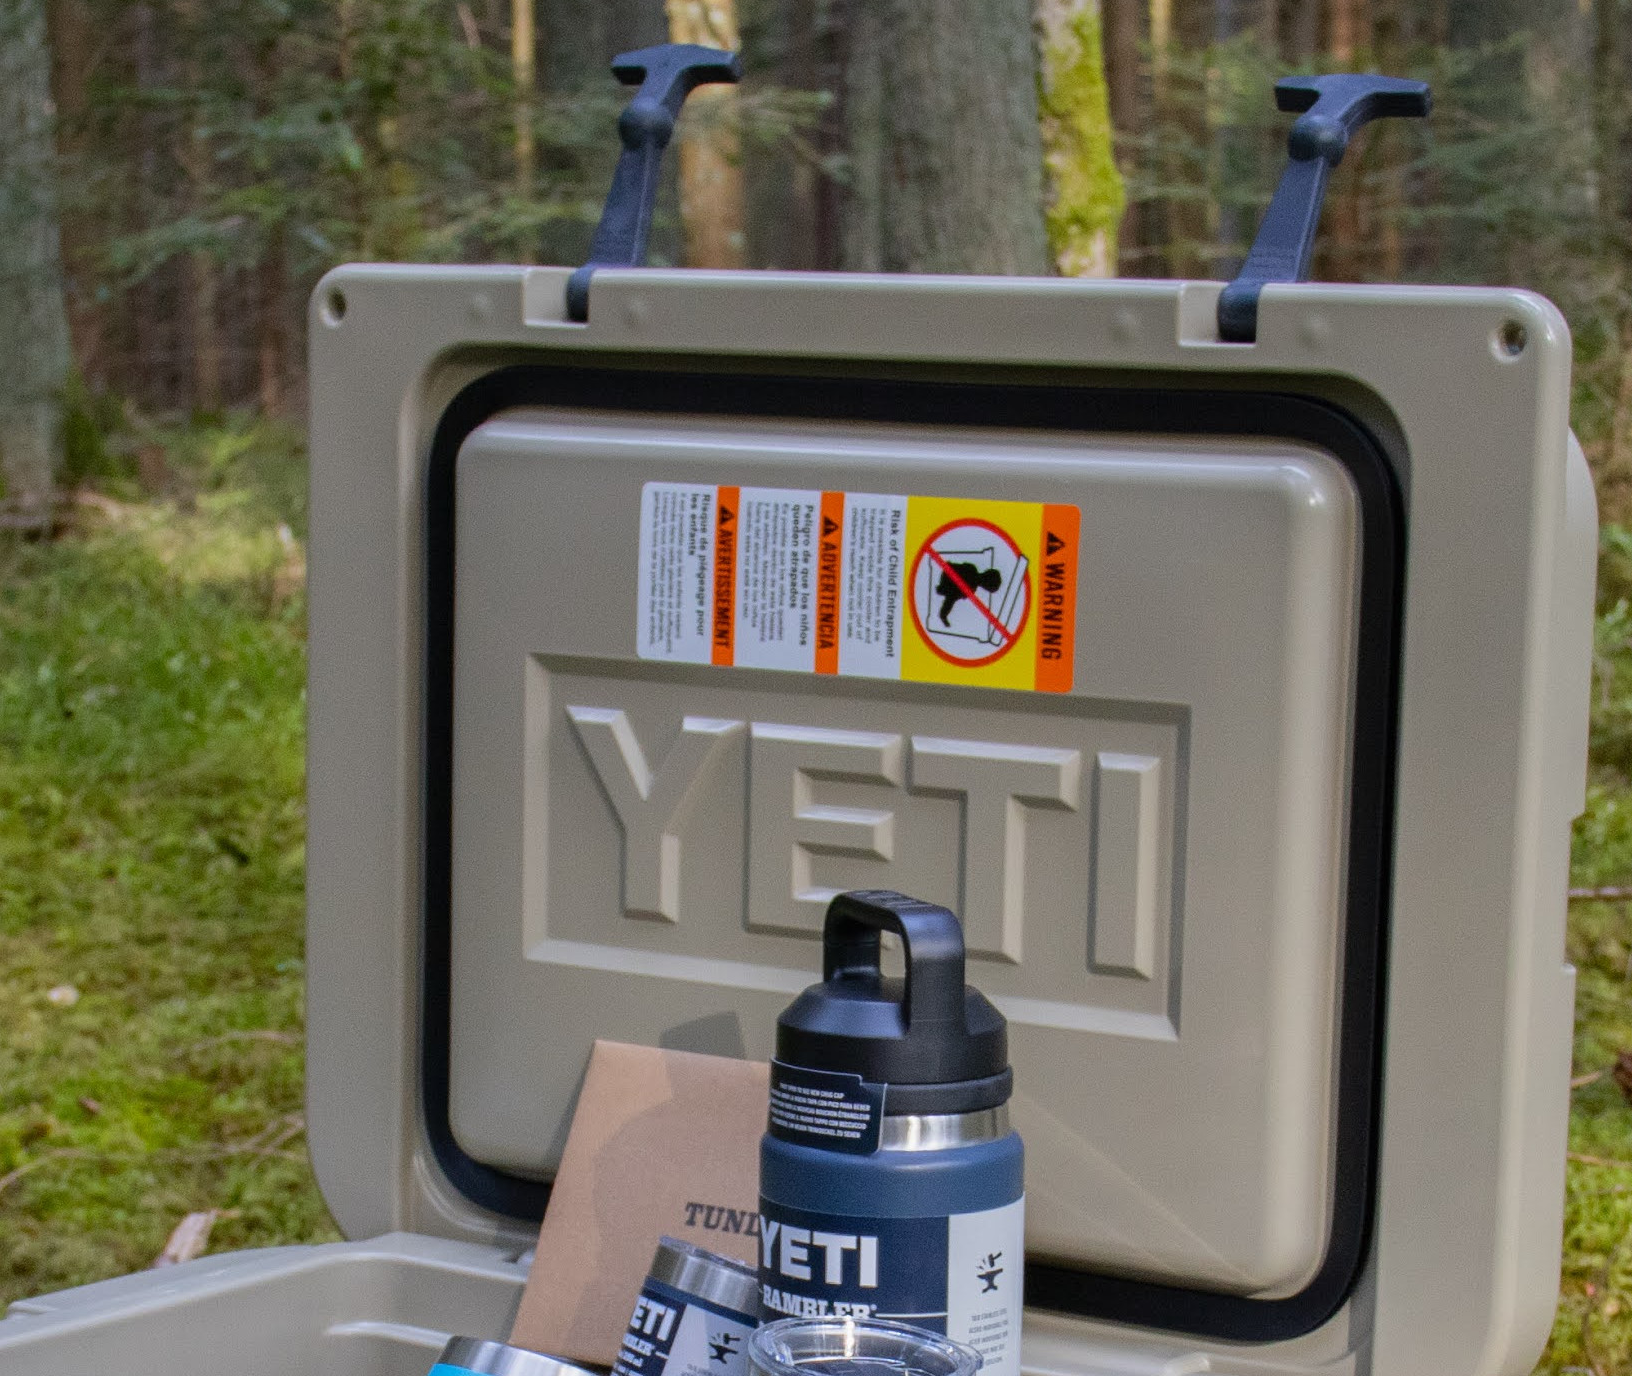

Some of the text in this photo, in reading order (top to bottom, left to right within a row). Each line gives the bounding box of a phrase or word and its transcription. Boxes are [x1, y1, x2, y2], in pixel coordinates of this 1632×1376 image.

[688, 493, 699, 556] les enfants
[700, 494, 711, 533] Risque
[700, 538, 708, 550] de
[715, 529, 733, 648] AVERTISSEMENT
[789, 505, 801, 608] queden atrapados
[799, 505, 814, 646] Peligro de que los niños
[818, 542, 837, 649] ADVERTENCIA
[885, 510, 900, 657] Risk of Child Entrapment
[696, 610, 705, 636] pour
[1041, 563, 1064, 660] WARNING
[566, 705, 1161, 978] YETI
[759, 1214, 878, 1288] YETI
[629, 1295, 677, 1341] ETI
[763, 1285, 870, 1319] RAMBLER
